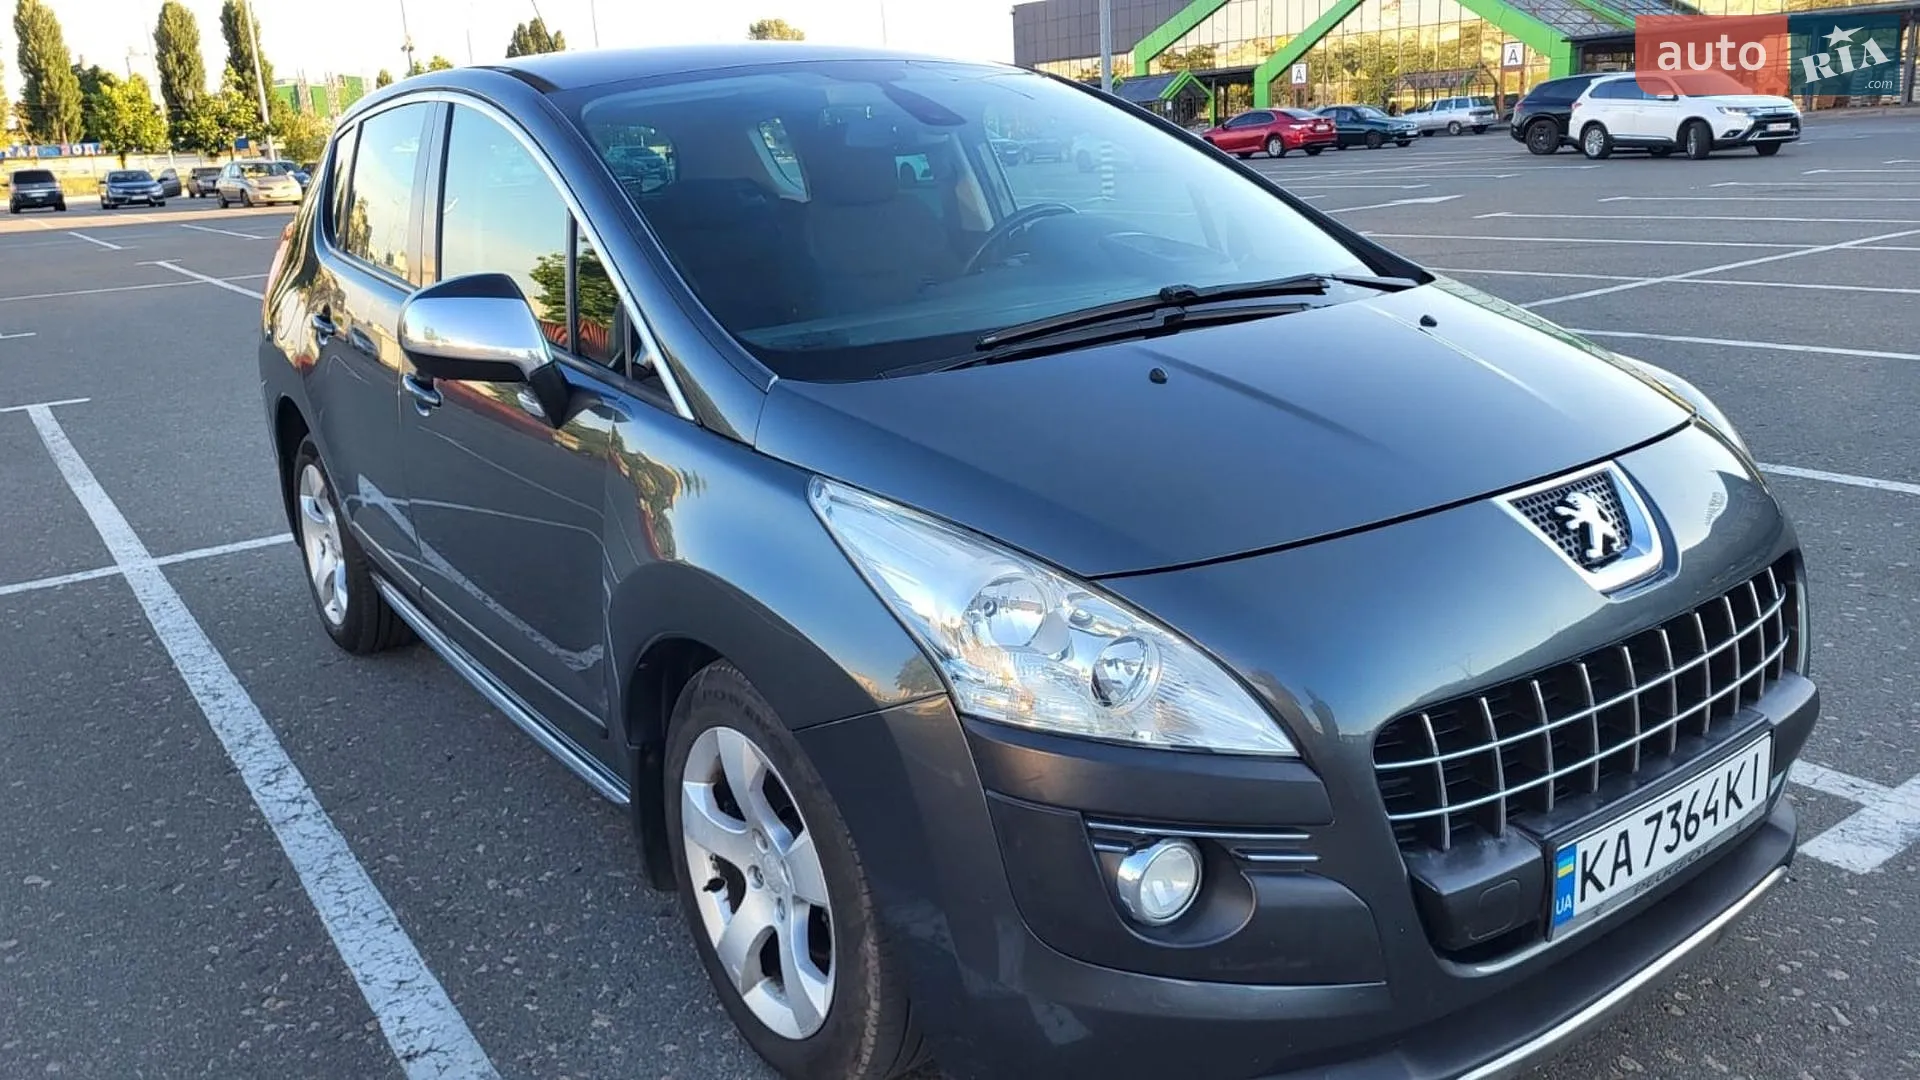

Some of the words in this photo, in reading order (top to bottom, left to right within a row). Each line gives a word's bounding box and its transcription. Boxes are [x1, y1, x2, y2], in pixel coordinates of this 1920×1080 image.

[1579, 829, 1633, 903] KA
[1644, 777, 1720, 868] 7364
[1555, 894, 1573, 915] UA
